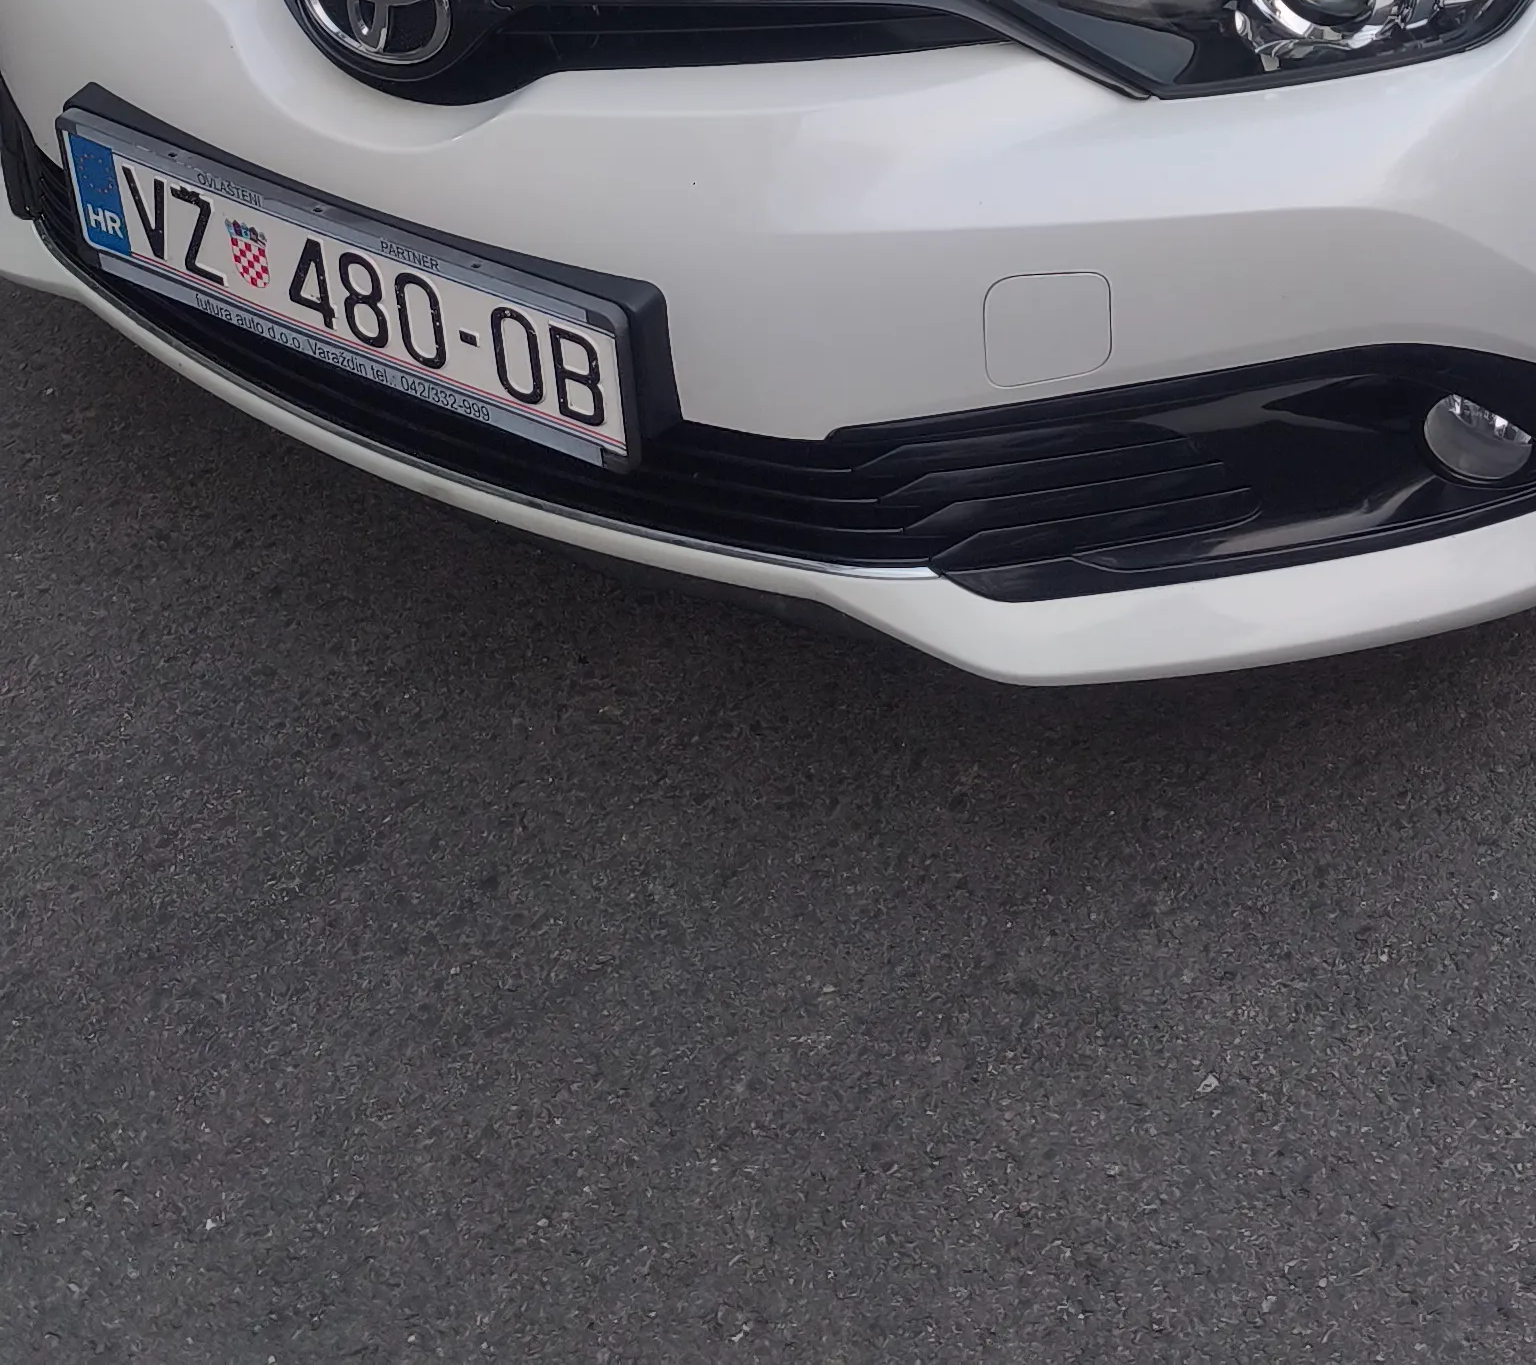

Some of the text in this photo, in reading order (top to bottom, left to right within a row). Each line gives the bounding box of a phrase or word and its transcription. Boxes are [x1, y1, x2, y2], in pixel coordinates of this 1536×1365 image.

[196, 171, 262, 208] OVLAŠTENI
[86, 203, 124, 239] HR
[380, 239, 441, 271] PARTNER
[195, 293, 233, 321] futura
[235, 313, 264, 335] auto
[307, 338, 368, 376] Varaždin
[400, 375, 490, 421] 042/332-999
